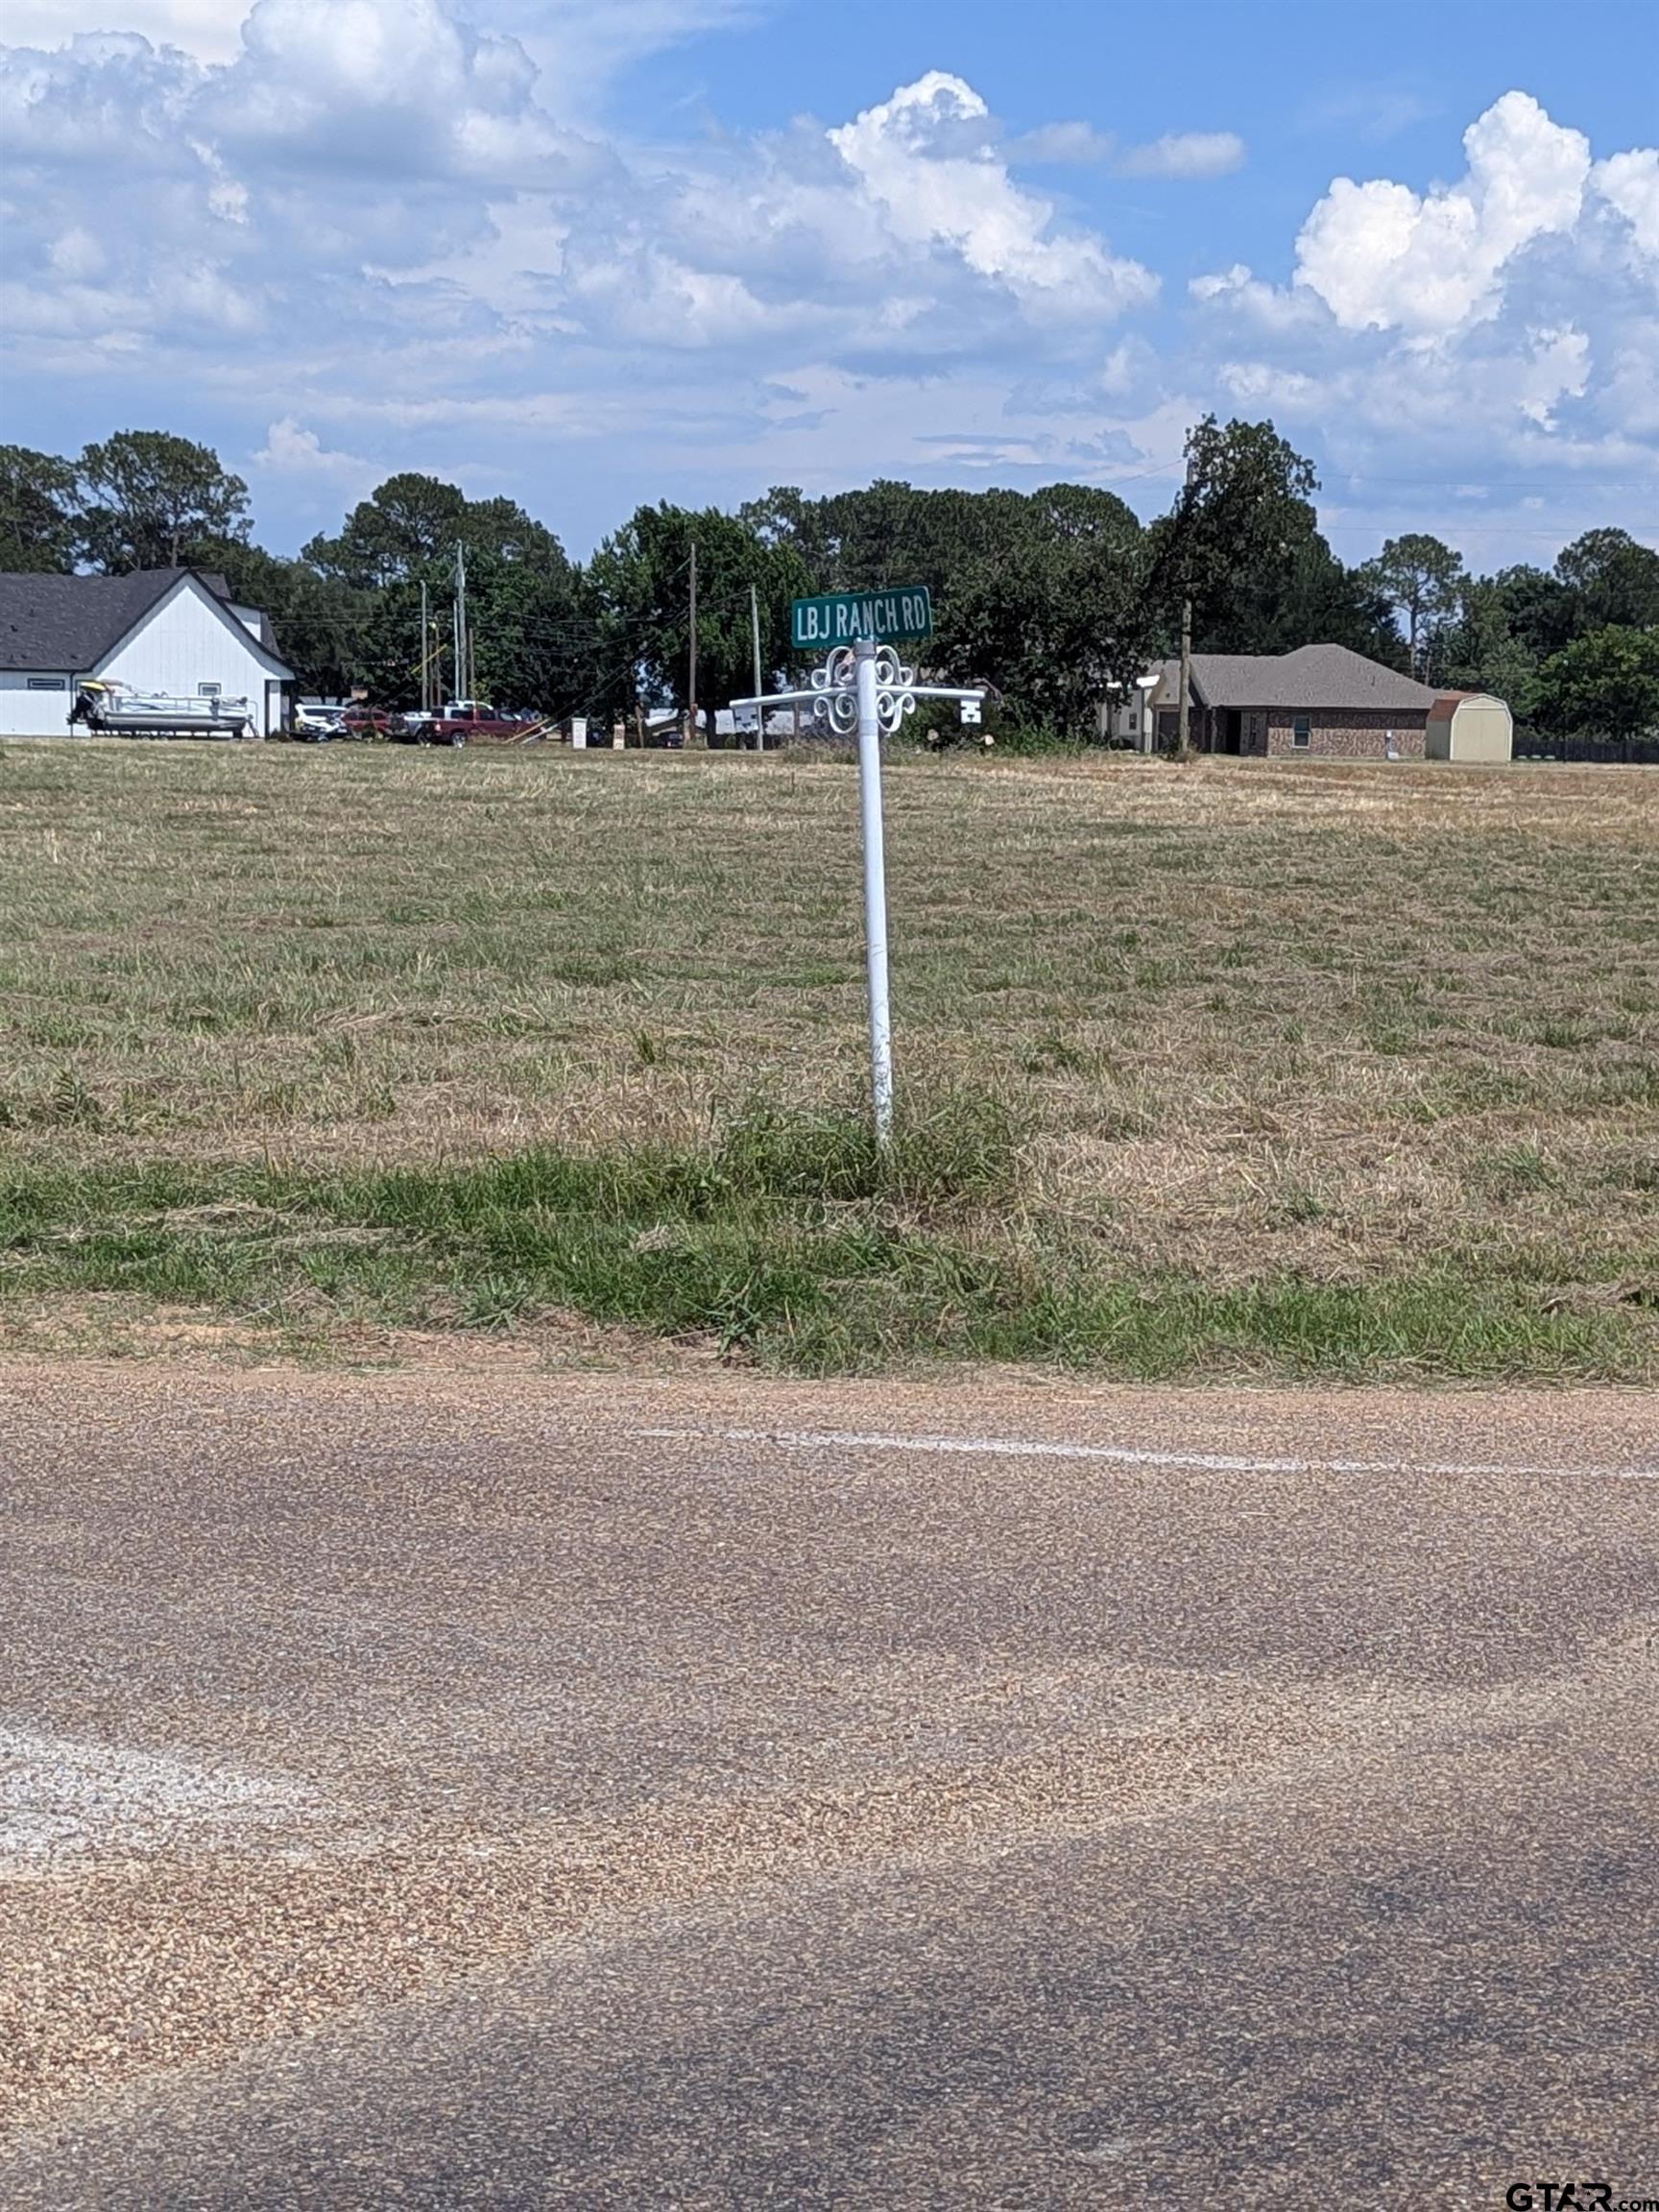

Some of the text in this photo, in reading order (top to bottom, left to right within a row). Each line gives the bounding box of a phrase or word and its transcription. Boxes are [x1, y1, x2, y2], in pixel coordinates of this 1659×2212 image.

[797, 594, 926, 641] LBJ RANCH RD
